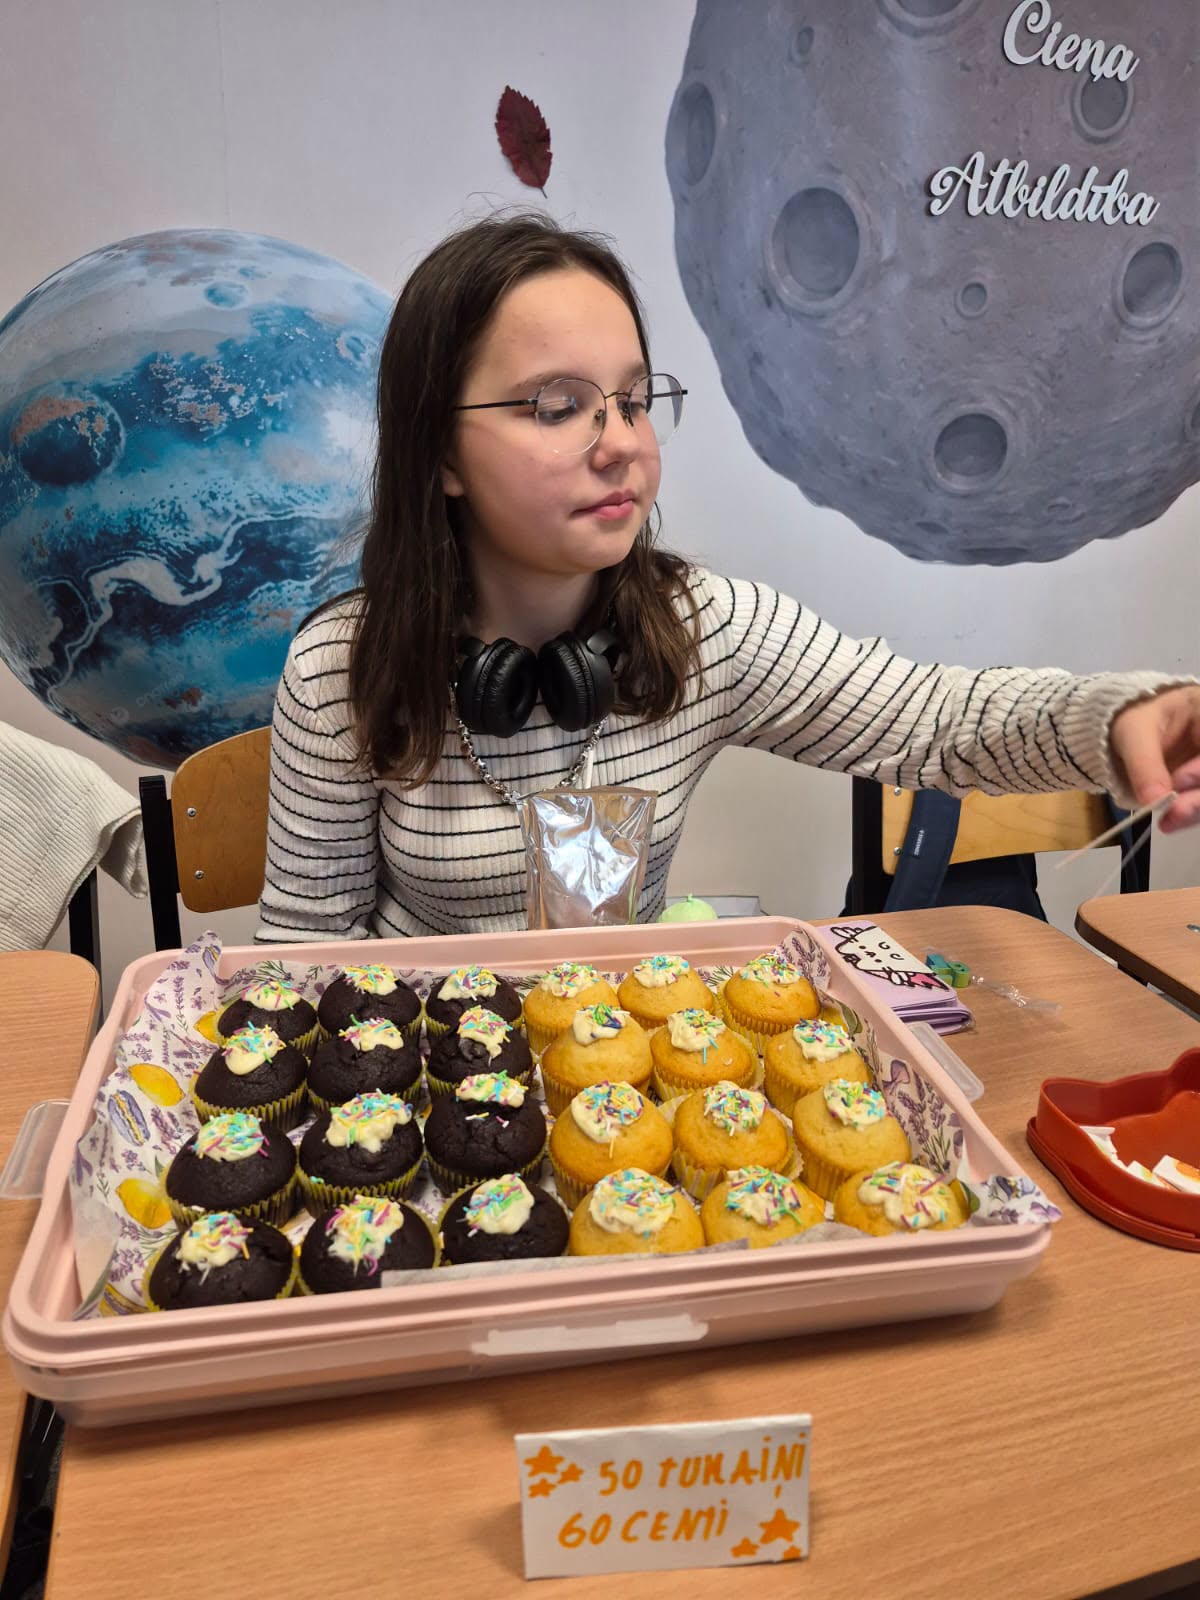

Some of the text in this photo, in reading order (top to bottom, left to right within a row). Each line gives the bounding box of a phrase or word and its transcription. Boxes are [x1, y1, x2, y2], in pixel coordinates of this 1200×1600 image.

[1003, 0, 1140, 82] Cieņa
[929, 151, 1160, 226] Atbildība
[599, 1459, 643, 1496] 50
[557, 1512, 612, 1549] 60
